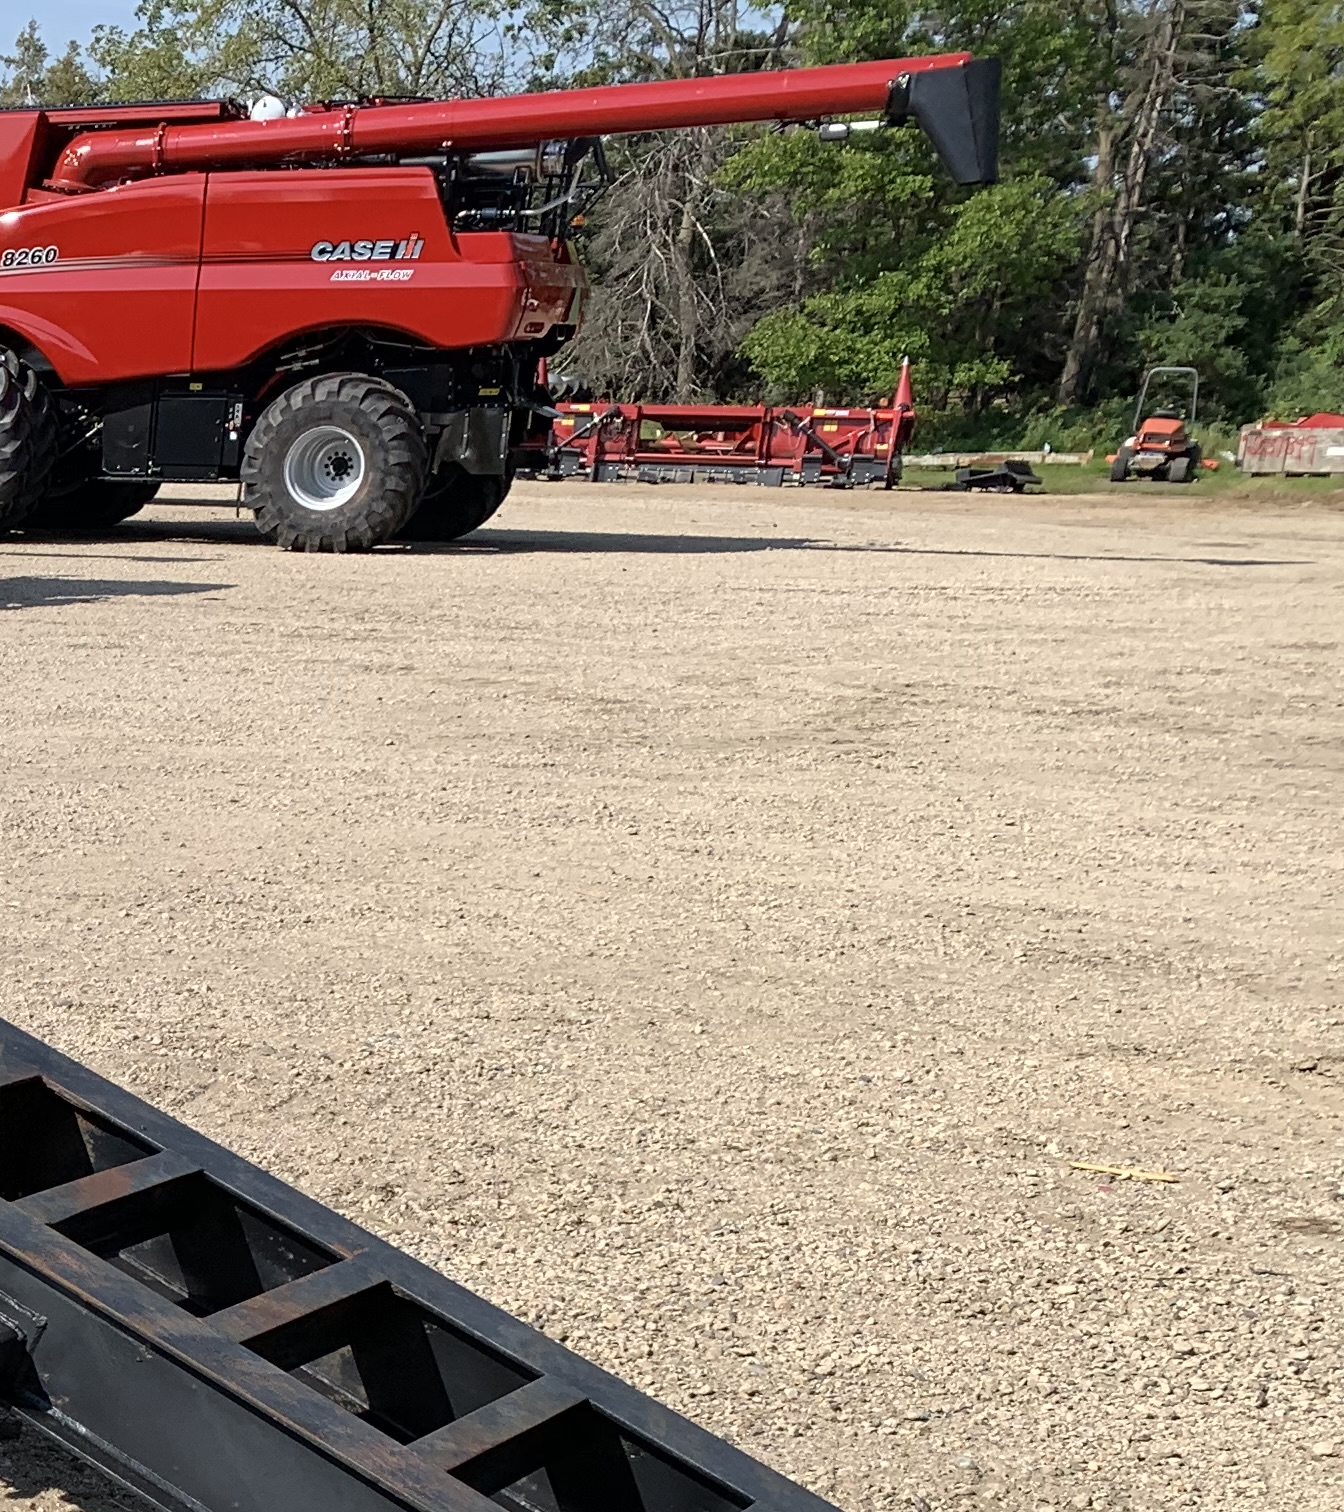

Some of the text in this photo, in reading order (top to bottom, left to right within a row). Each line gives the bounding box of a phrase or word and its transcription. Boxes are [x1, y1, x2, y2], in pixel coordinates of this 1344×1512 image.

[0, 245, 59, 267] 8260
[311, 240, 394, 262] CASE
[330, 269, 415, 281] AXIAL-FLOW
